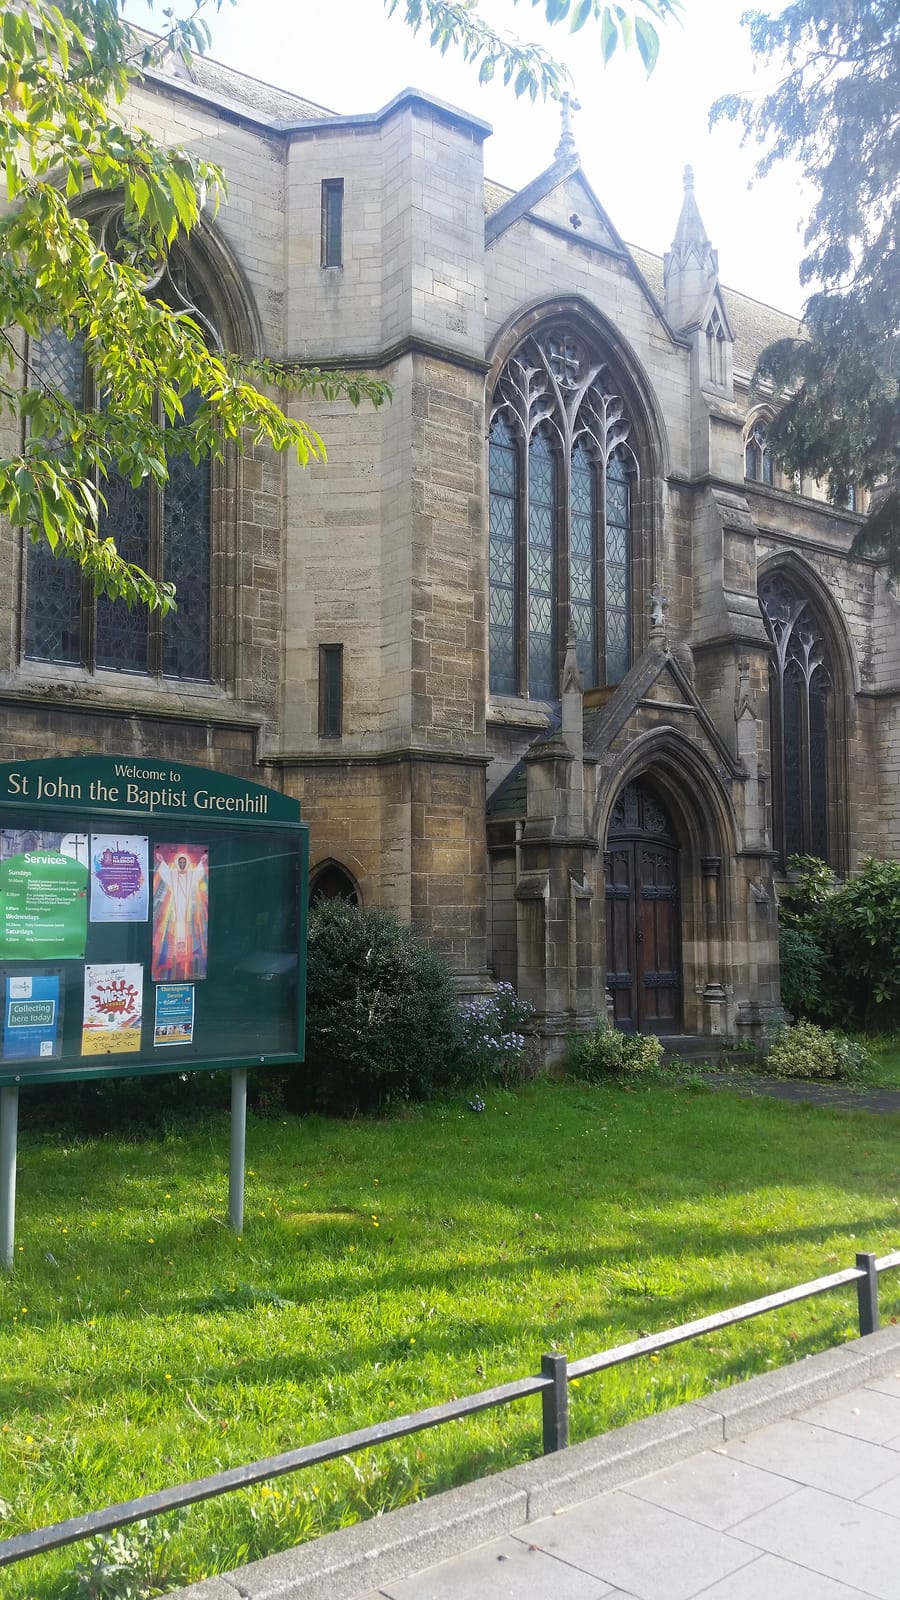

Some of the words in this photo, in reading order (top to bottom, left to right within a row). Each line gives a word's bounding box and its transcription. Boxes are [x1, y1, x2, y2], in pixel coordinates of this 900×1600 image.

[114, 764, 166, 781] Welcome
[169, 770, 181, 782] to
[7, 773, 29, 795] St
[37, 775, 81, 800] John
[89, 779, 119, 802] the
[126, 783, 187, 812] Baptist
[193, 790, 268, 814] Greenhill
[24, 853, 67, 865] Services
[13, 1003, 51, 1014] Collecting
[11, 1014, 29, 1023] here
[30, 1013, 52, 1023] today
